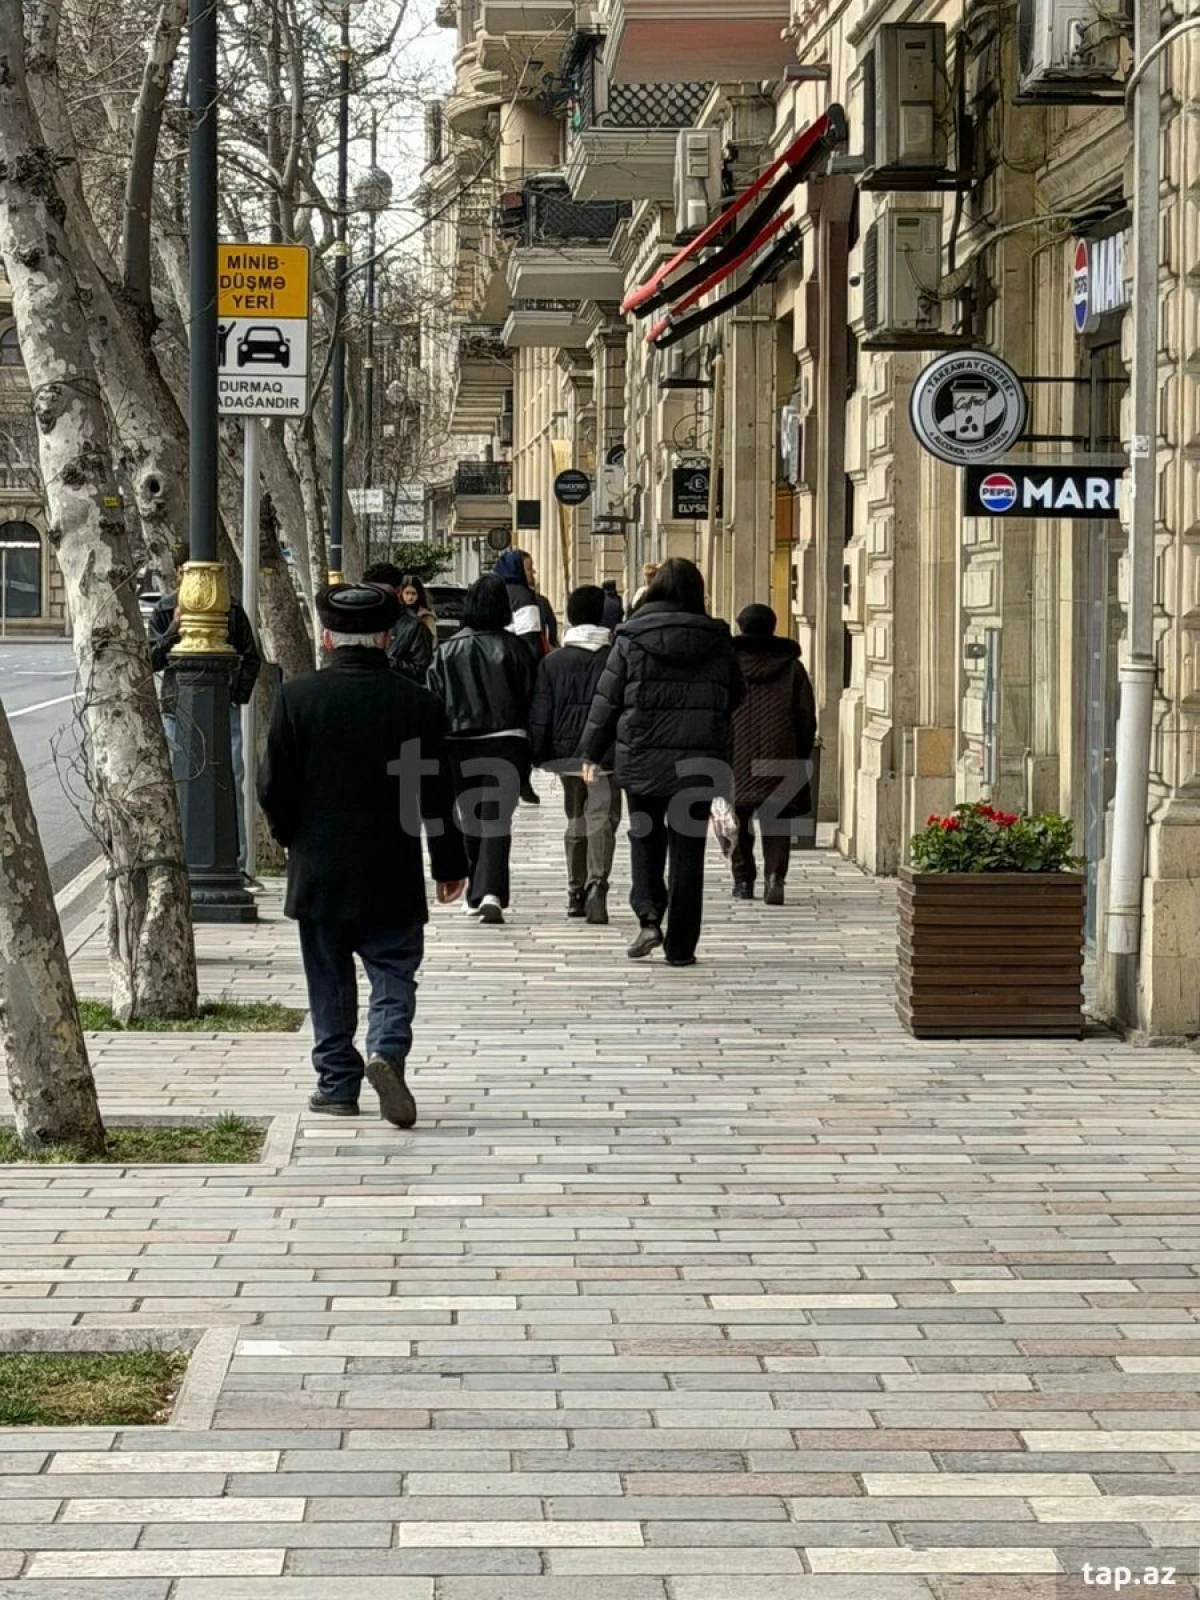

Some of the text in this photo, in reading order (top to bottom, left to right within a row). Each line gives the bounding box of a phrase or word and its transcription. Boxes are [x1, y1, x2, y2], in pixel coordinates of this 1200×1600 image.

[220, 272, 286, 292] DÜŞMƏ
[232, 292, 275, 310] YERİ
[927, 360, 1014, 392] TAKEAWAY COFFEE
[219, 381, 283, 394] DURMAQ
[982, 487, 1015, 497] PEPSI
